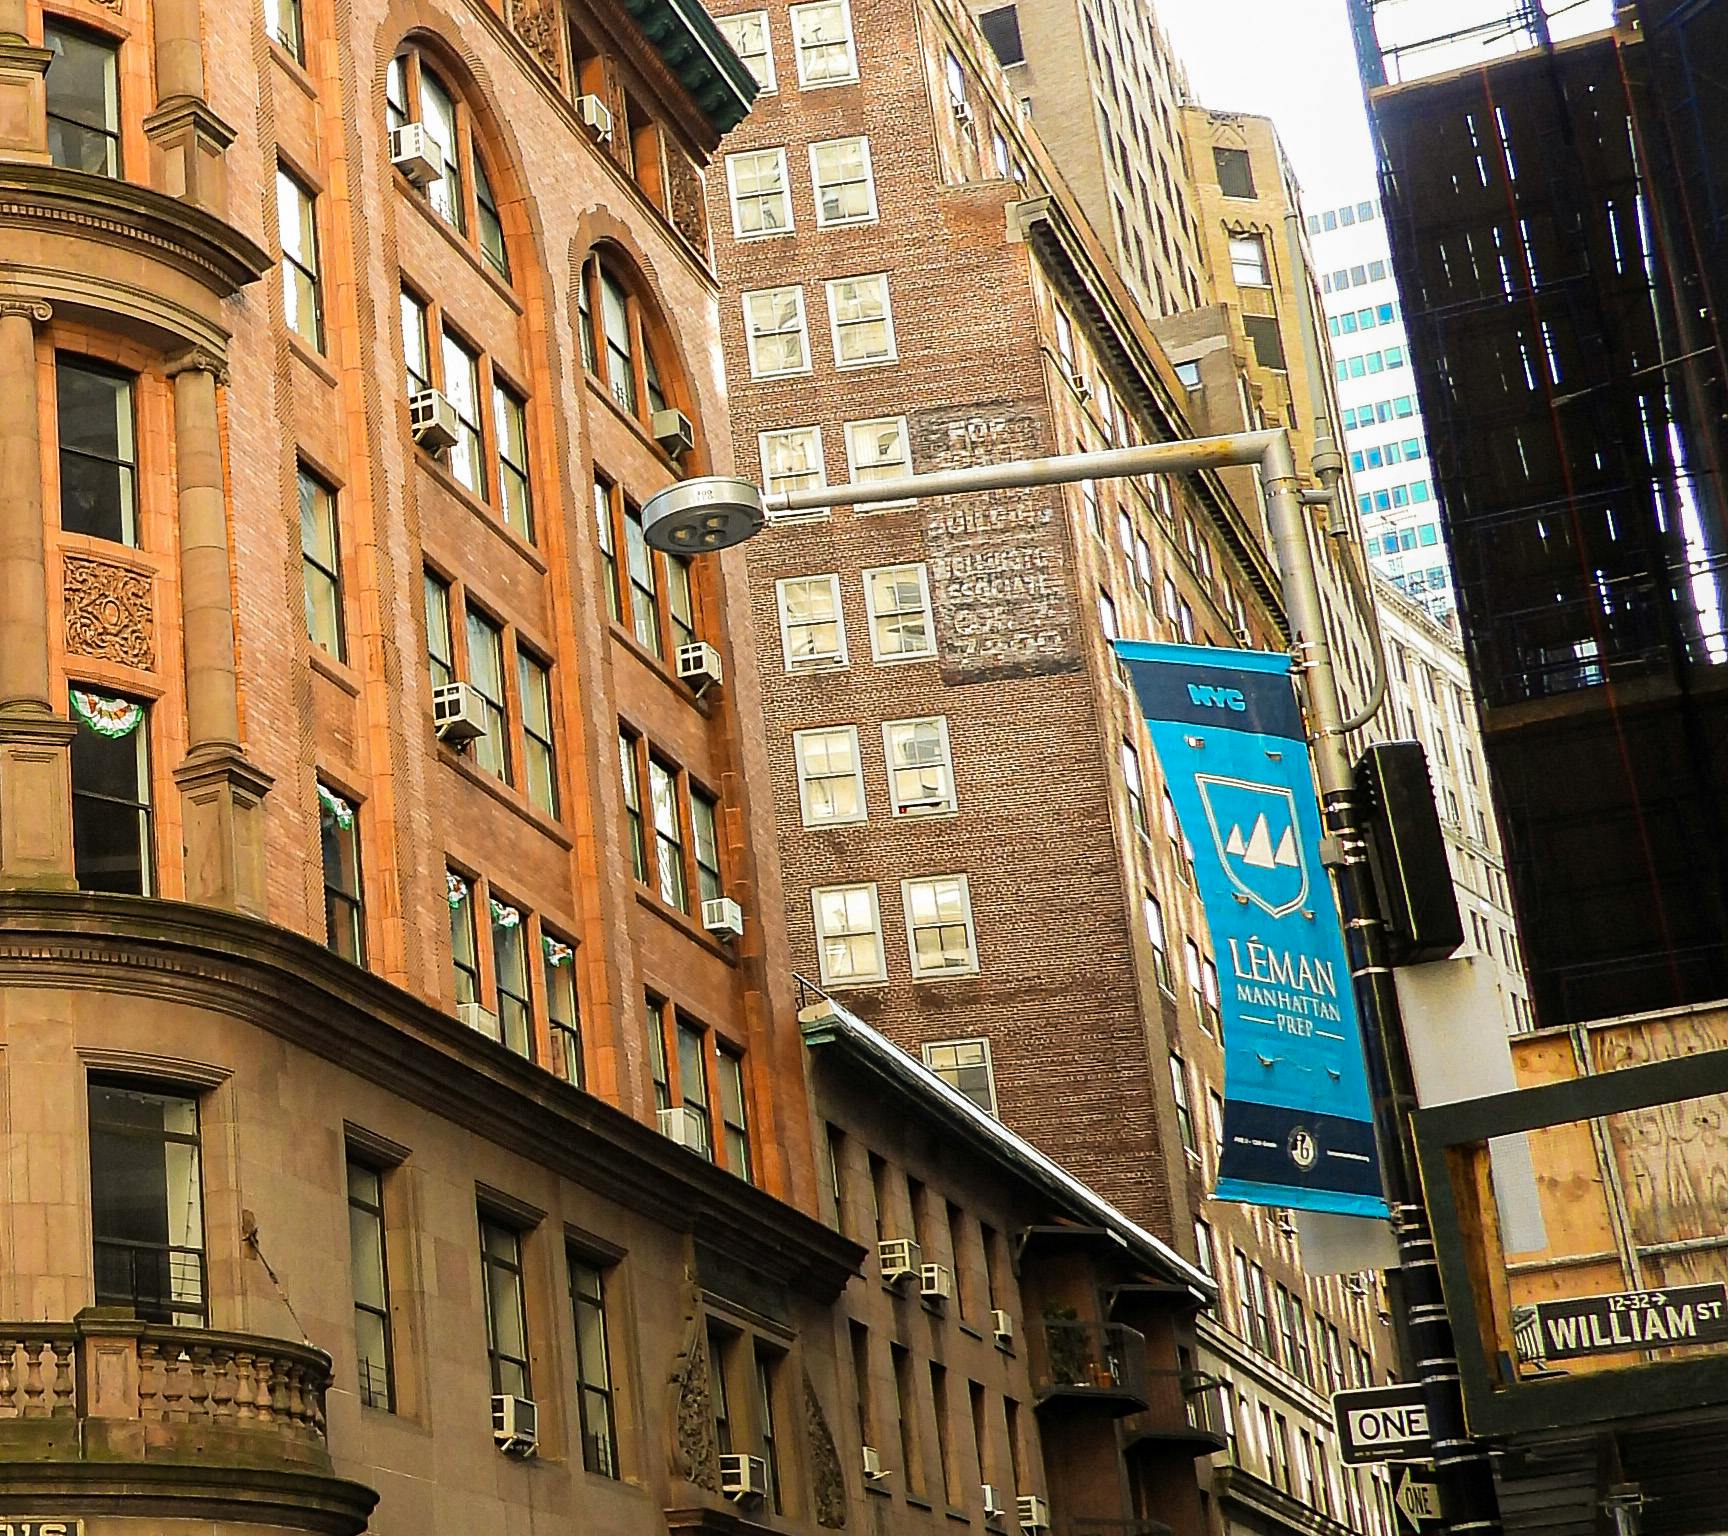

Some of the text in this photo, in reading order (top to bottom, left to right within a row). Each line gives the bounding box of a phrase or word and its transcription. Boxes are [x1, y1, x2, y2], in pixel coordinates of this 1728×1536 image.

[1187, 683, 1246, 711] NYC
[1228, 936, 1336, 998] LÉMAN
[1237, 984, 1341, 1022] MANHATTAN
[1277, 1014, 1313, 1037] PREP
[1609, 1293, 1651, 1312] 12-32
[1547, 1302, 1722, 1350] WILLIAM ST
[1358, 1409, 1429, 1441] ONE
[1405, 1487, 1432, 1515] ONE
